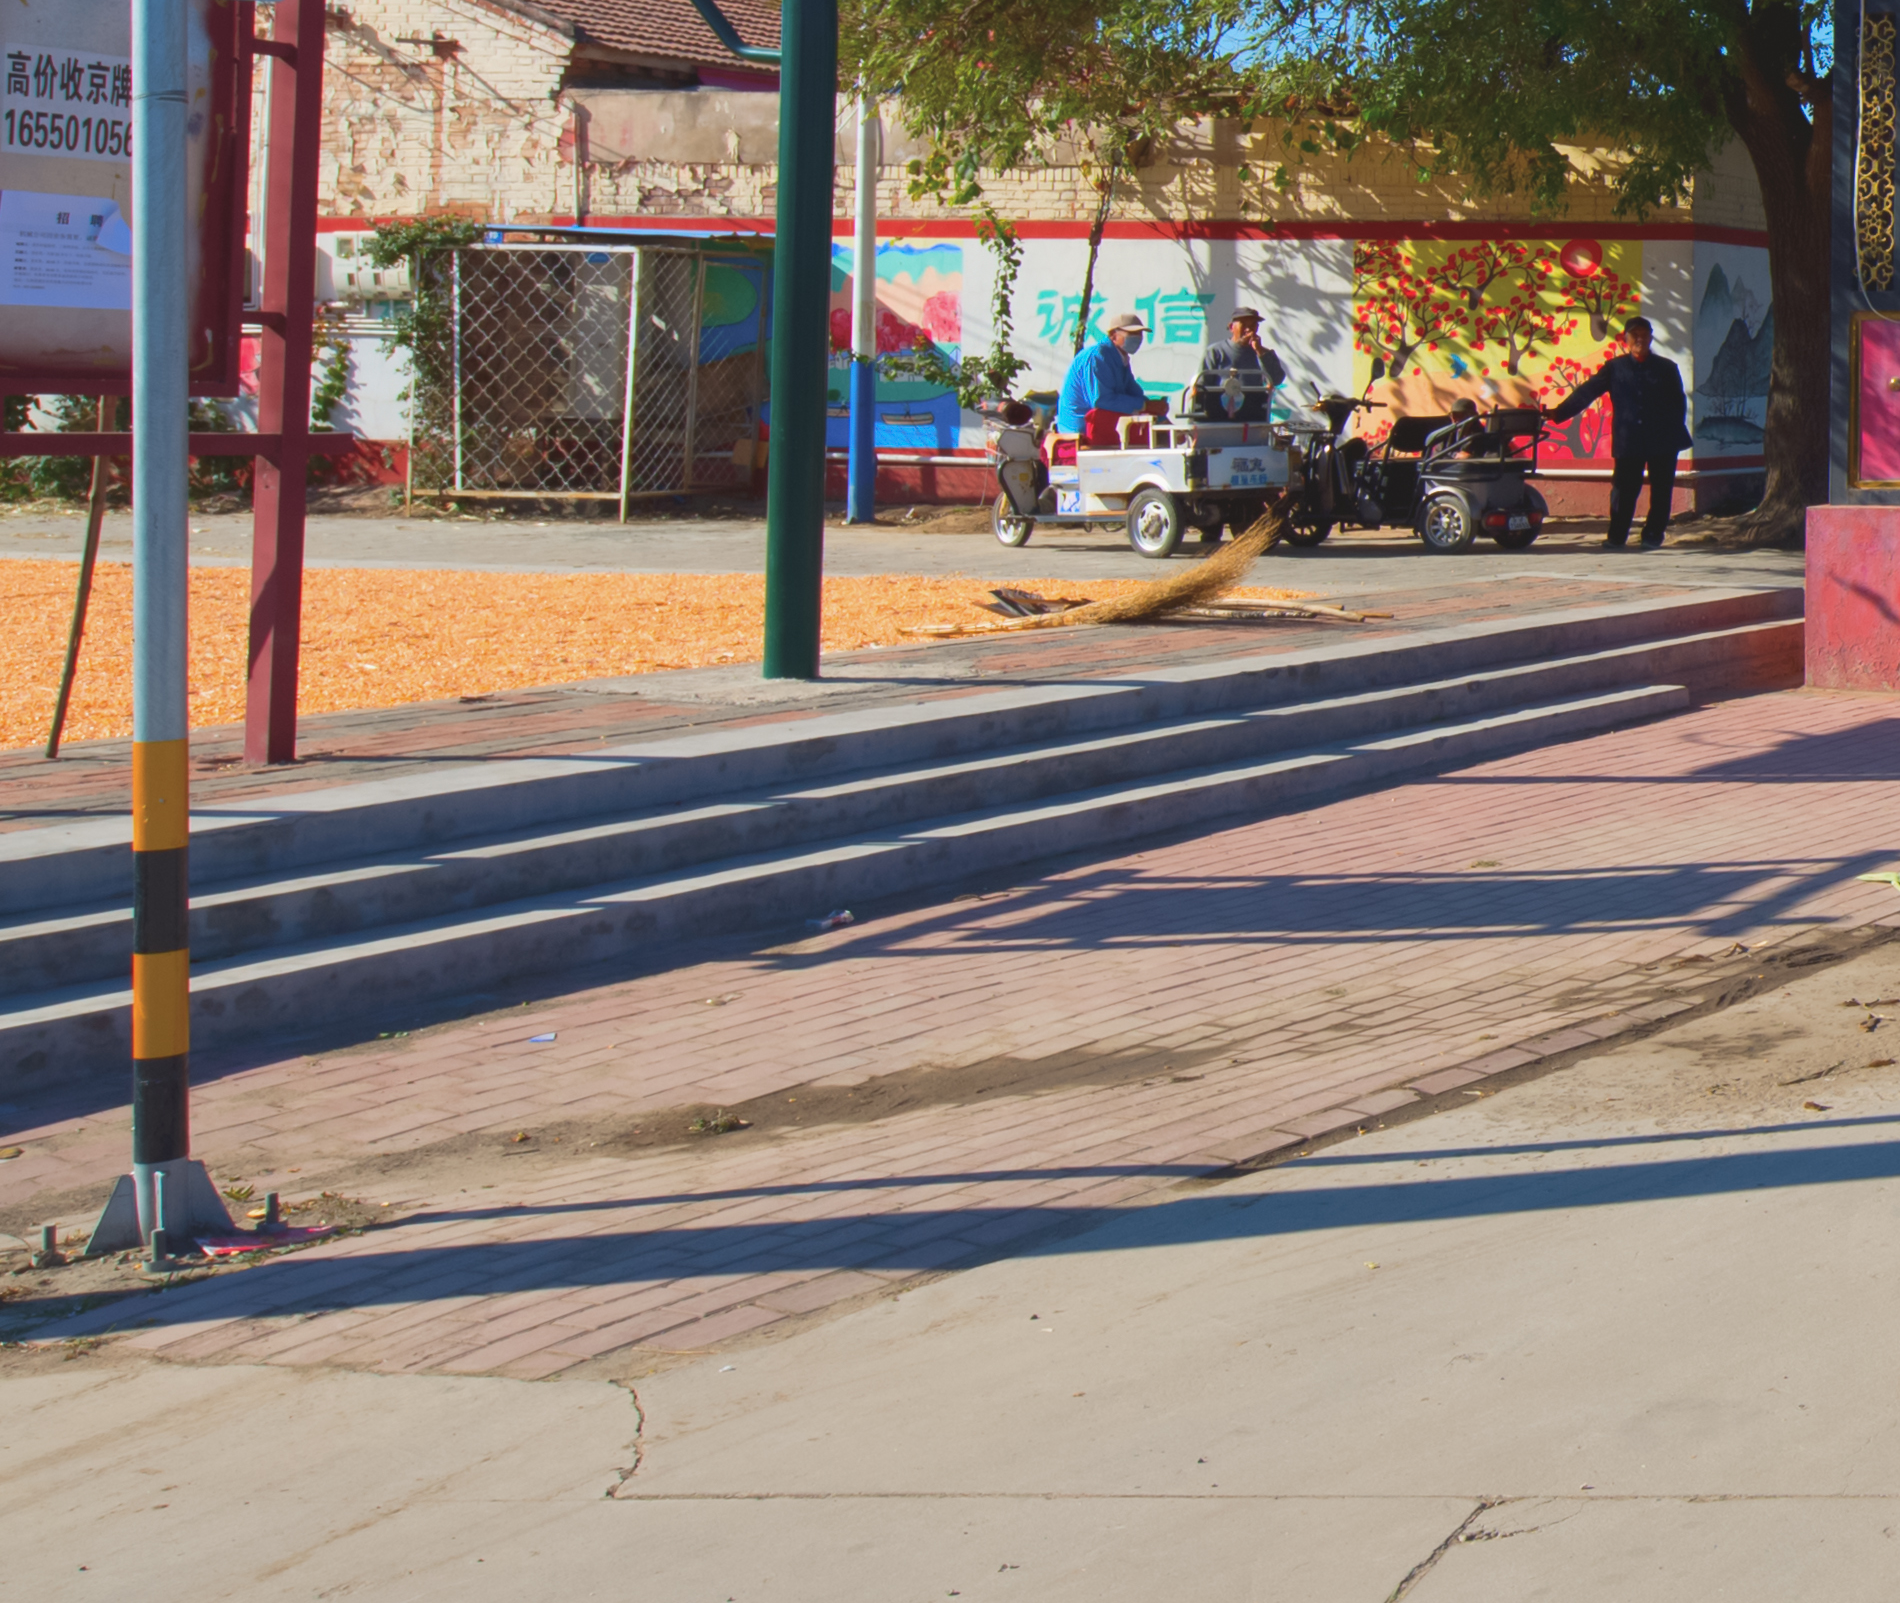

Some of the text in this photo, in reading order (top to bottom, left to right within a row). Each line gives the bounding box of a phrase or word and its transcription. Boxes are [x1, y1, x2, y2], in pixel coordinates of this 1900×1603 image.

[6, 50, 132, 108] 高价收京牌
[1037, 286, 1216, 345] 诚信
